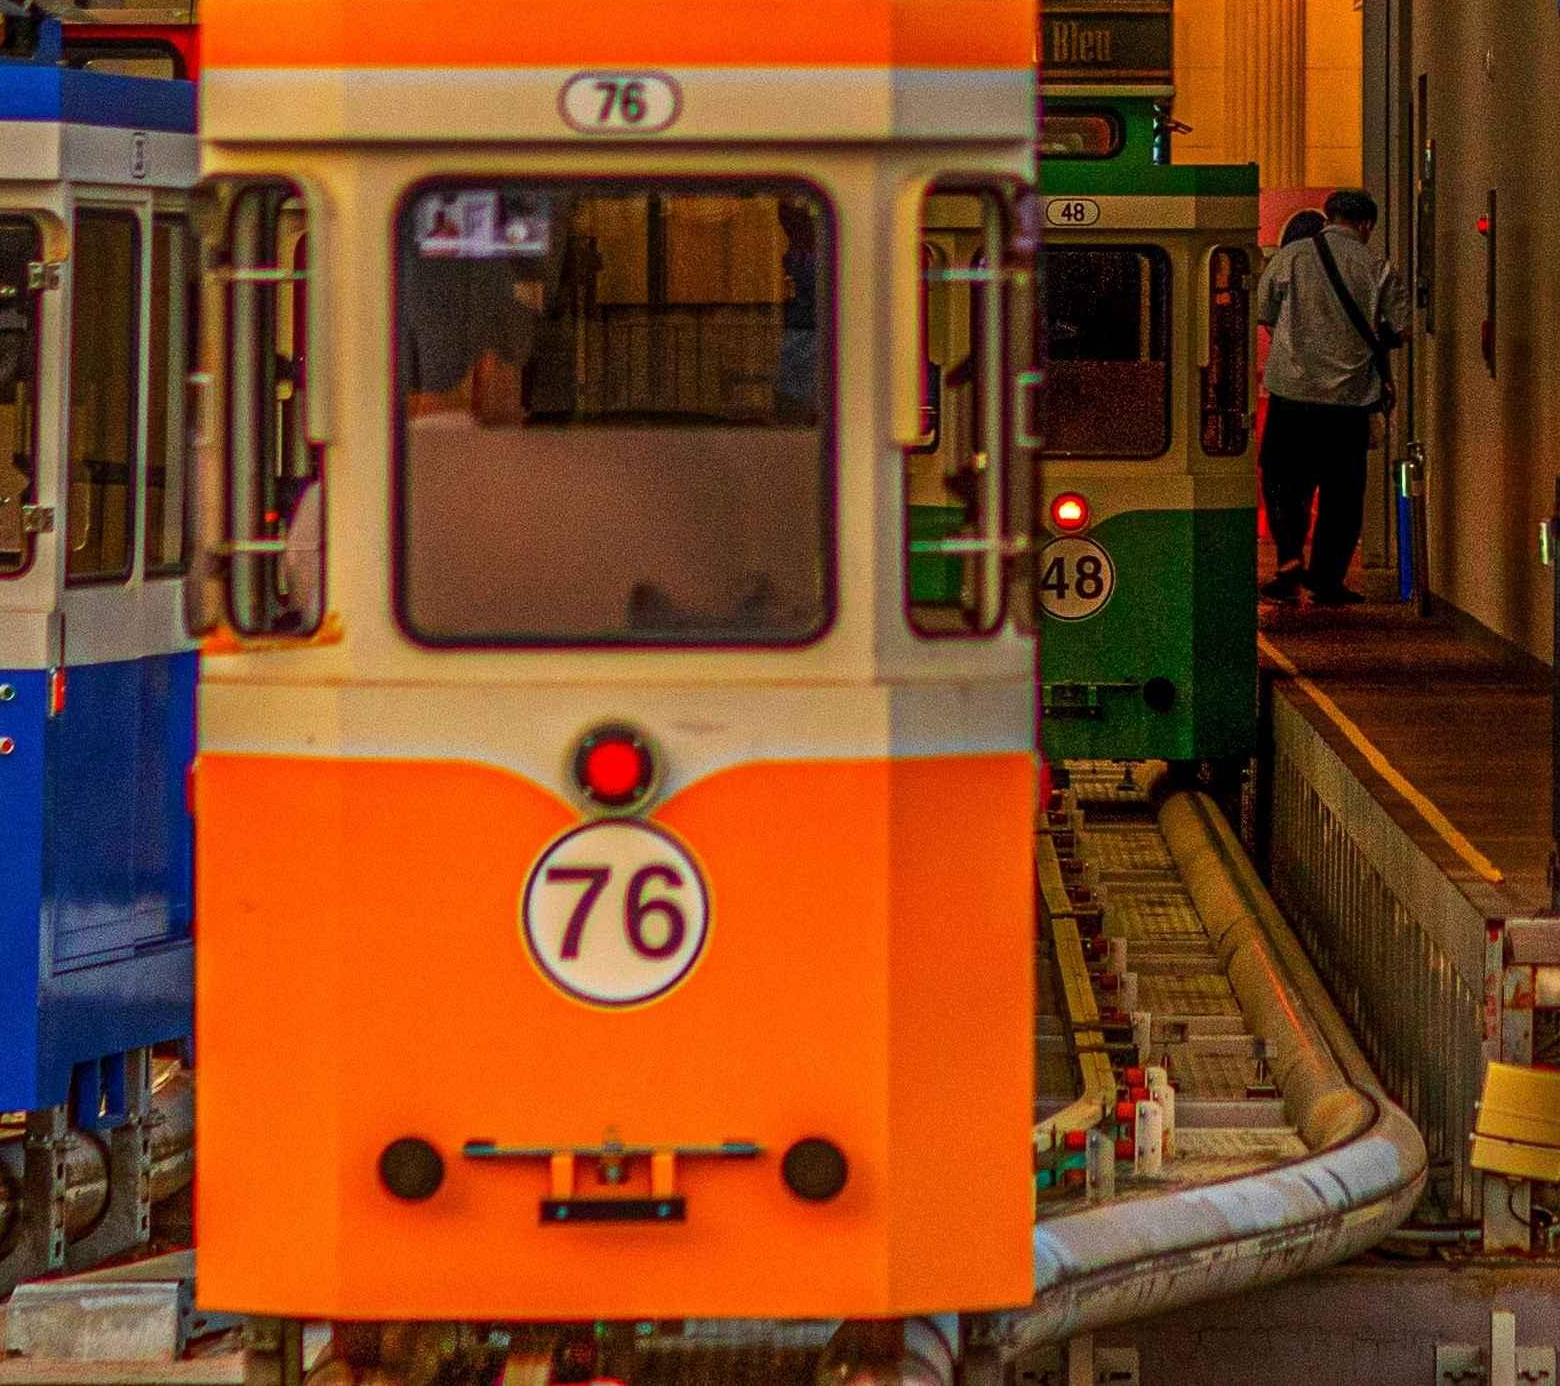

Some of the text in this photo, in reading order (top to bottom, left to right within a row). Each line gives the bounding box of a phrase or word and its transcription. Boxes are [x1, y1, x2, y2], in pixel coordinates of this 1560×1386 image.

[594, 81, 648, 123] 76
[1060, 202, 1085, 222] 48
[1039, 555, 1104, 600] 48
[545, 863, 686, 961] 76
